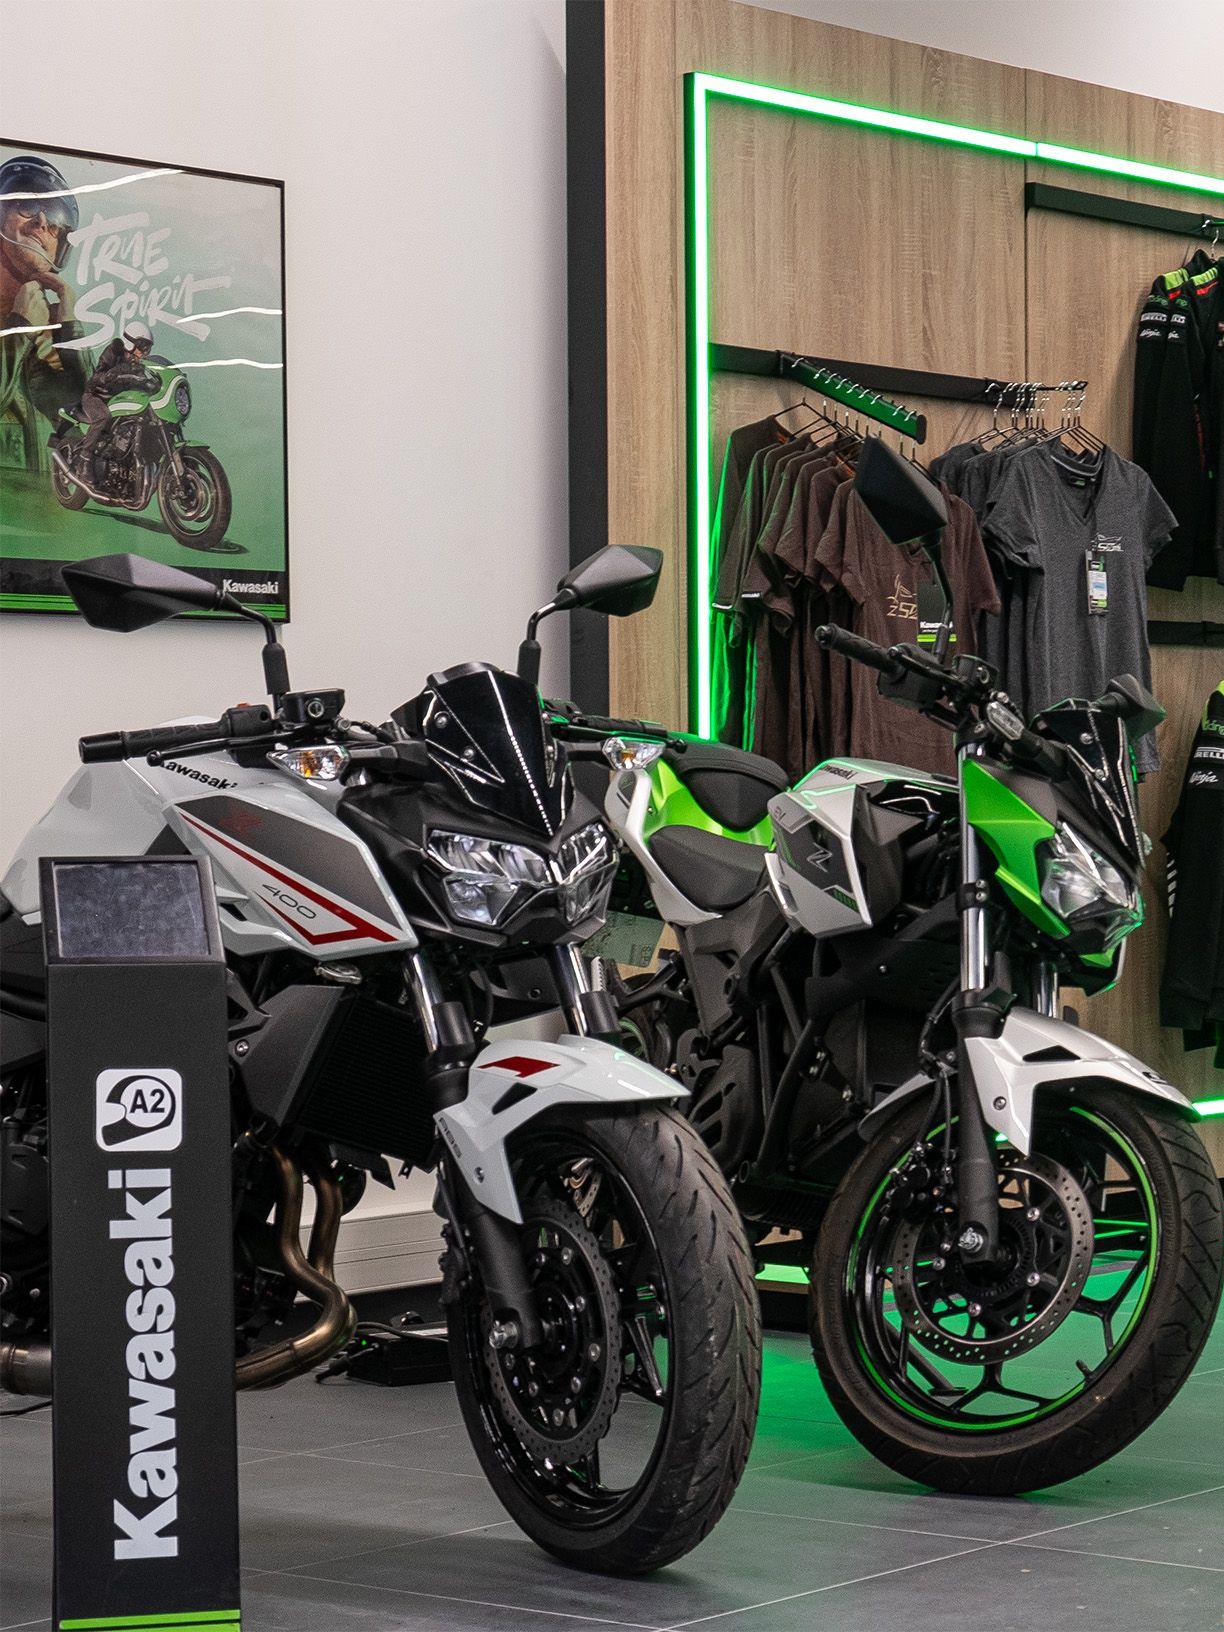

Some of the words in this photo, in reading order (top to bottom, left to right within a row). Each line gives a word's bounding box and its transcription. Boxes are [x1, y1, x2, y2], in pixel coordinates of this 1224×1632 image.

[222, 579, 279, 595] Kawasaki
[262, 883, 317, 920] 400
[129, 1088, 166, 1114] A2
[108, 1167, 179, 1562] Kawasaki
